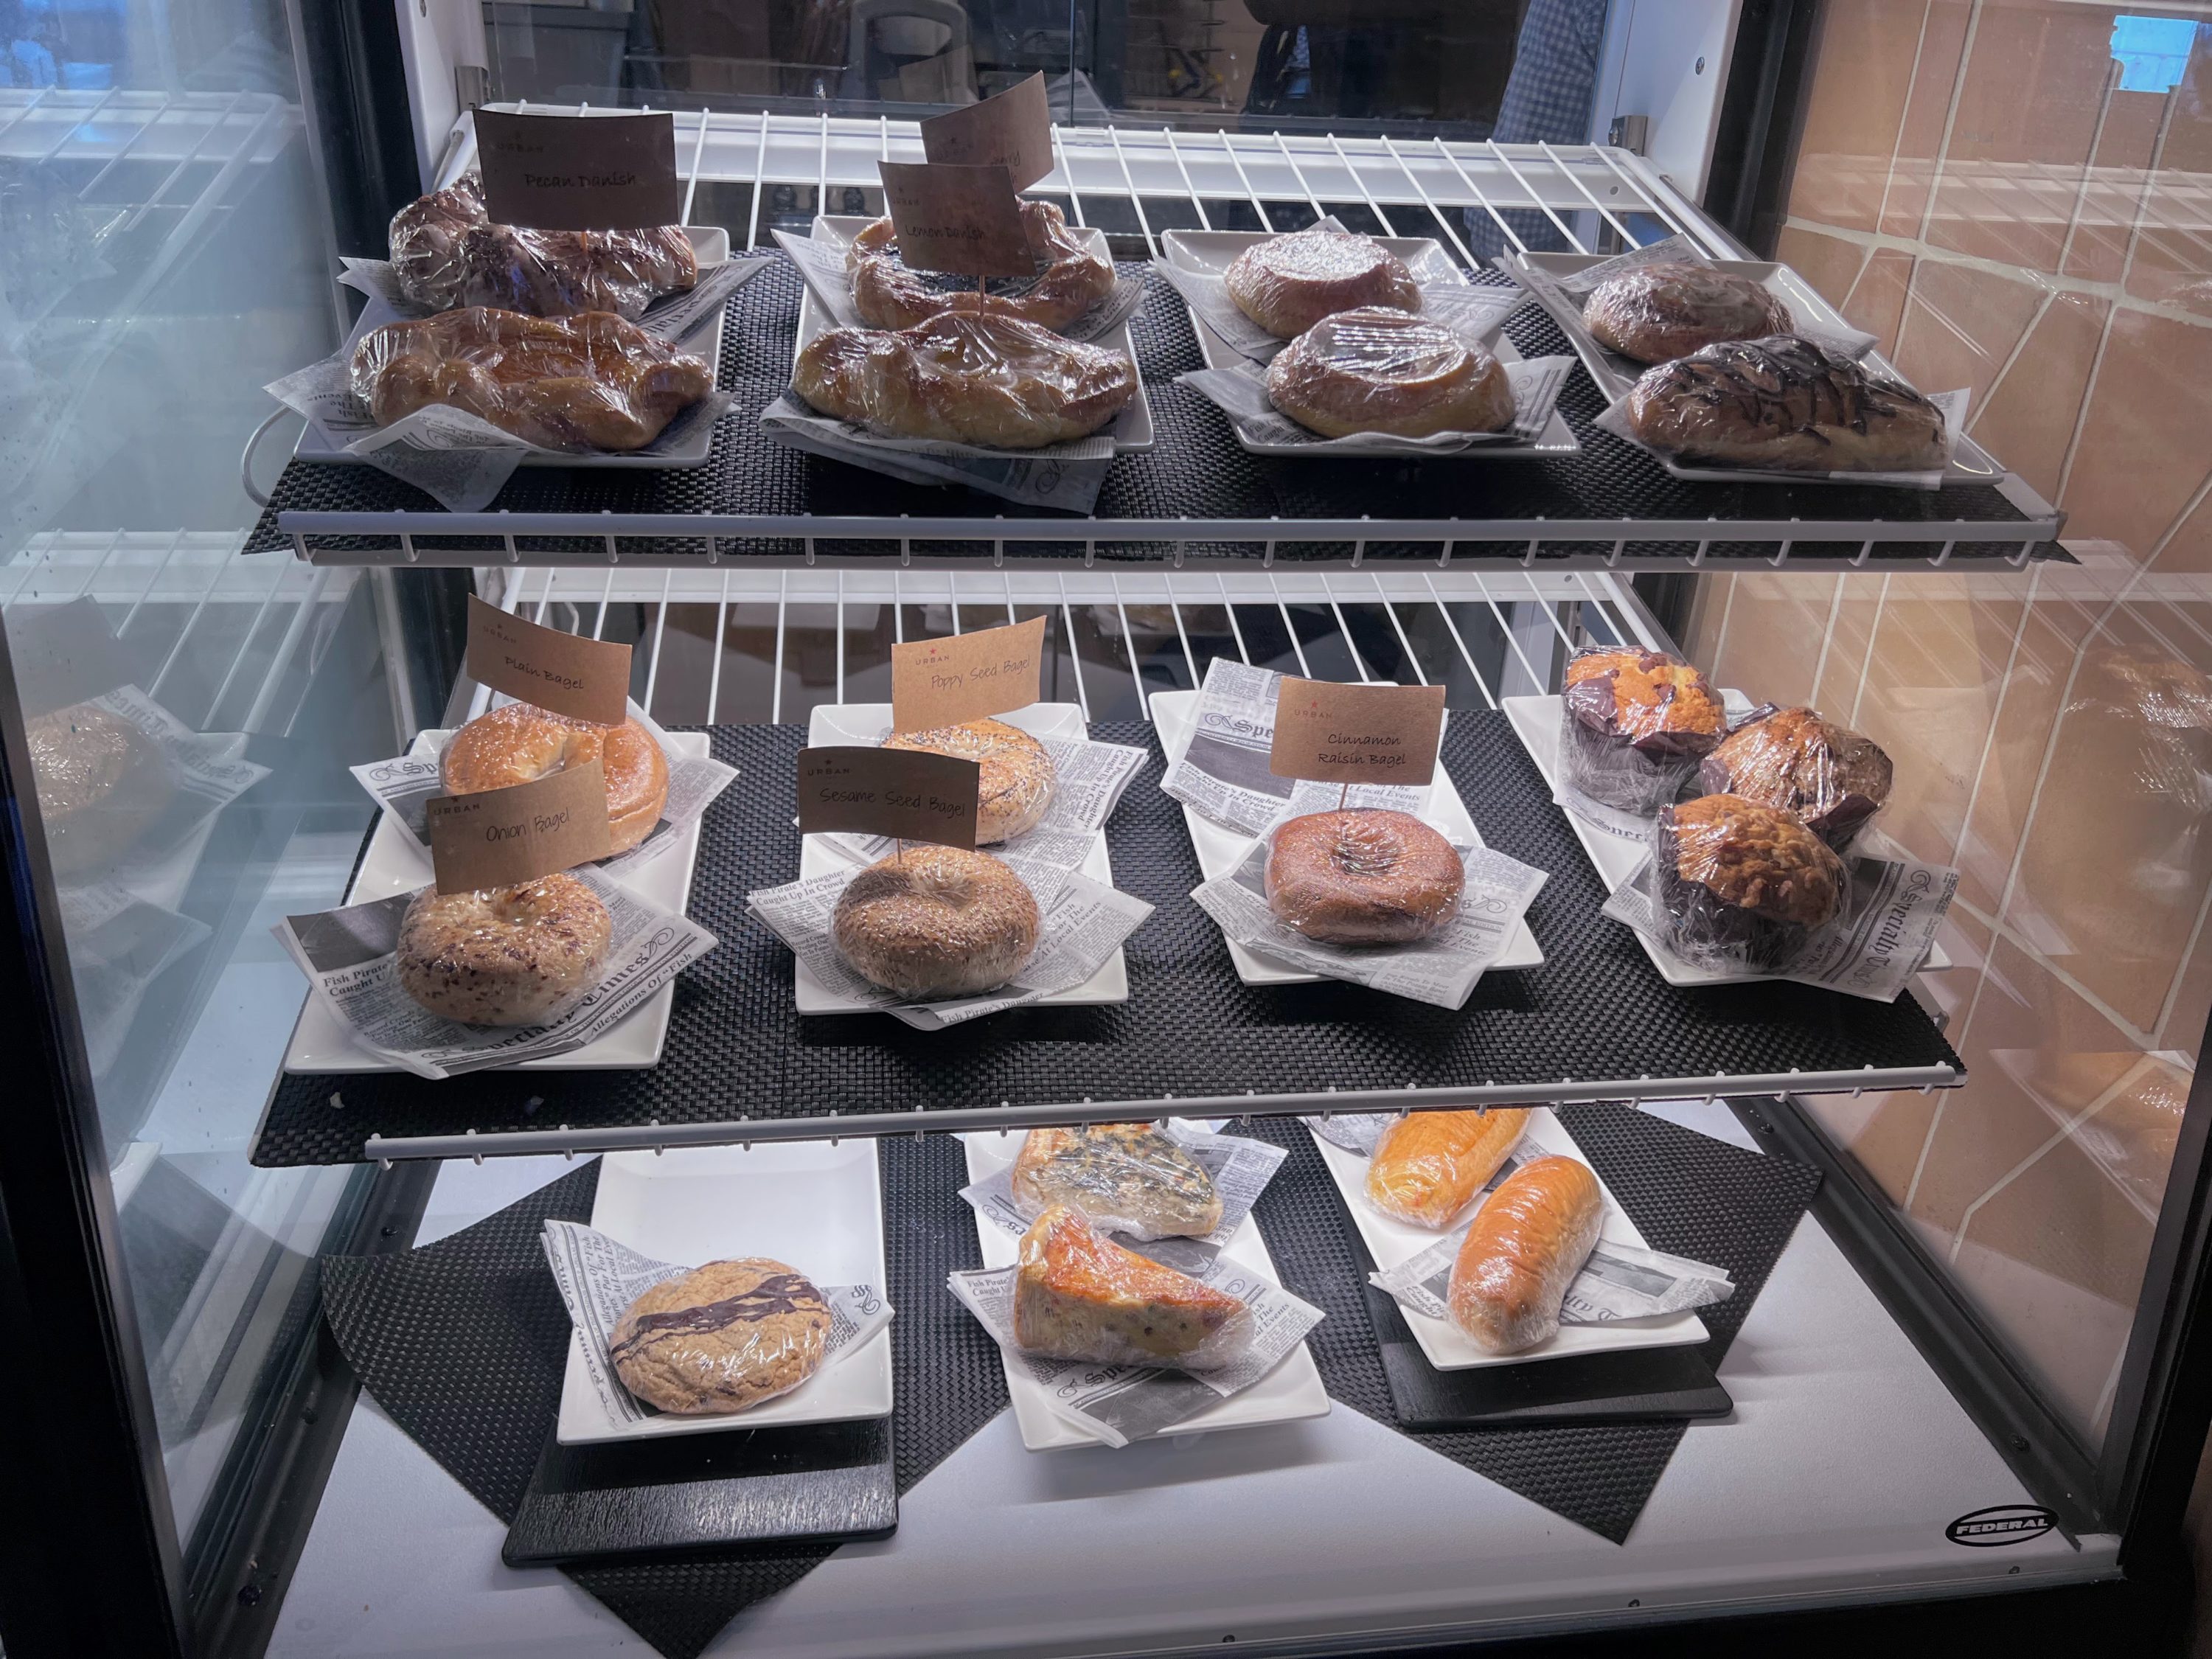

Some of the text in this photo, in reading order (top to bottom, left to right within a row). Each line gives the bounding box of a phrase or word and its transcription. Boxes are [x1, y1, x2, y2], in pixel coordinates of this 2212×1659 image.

[524, 172, 636, 187] Pecan Danish
[905, 224, 945, 239] Lemon
[916, 655, 950, 666] URBAN
[504, 655, 584, 689] Plain Bagel
[931, 655, 1031, 690] Poppy Seed Bagel
[1294, 709, 1332, 720] URBAN
[1327, 733, 1402, 745] Cinnamon
[1318, 751, 1406, 768] Raisin Bagel
[807, 767, 851, 777] URBAN
[1077, 749, 1124, 821] Caught Up In Crowd
[1356, 785, 1421, 801] Local Events
[820, 787, 965, 818] Sesame Seed Bagel
[1238, 790, 1286, 807] Daughter
[1242, 797, 1276, 812] Crowd
[434, 803, 481, 815] URBAN
[1084, 790, 1106, 829] Daughter
[486, 807, 571, 843] Onion Bagel
[771, 880, 804, 894] Pirate's
[805, 869, 845, 886] Daughter
[756, 878, 846, 907] Caught Up In Crowd
[1068, 905, 1085, 920] The
[1049, 925, 1074, 950] Local
[1074, 900, 1102, 927] Events
[1868, 889, 1924, 956] Specialty
[323, 961, 390, 988] Fish Pirate'
[581, 949, 650, 1007] Times
[329, 978, 374, 998] Caught
[591, 952, 693, 1037] Allegations Of "Fish
[964, 1004, 1000, 1019] Pirate's
[592, 1236, 602, 1247] The
[597, 1255, 608, 1274] For
[608, 1256, 619, 1281] Local
[584, 1237, 613, 1326] Allegations Of "Fish
[602, 1280, 611, 1295] Par
[967, 1278, 985, 1288] Fish
[972, 1286, 1003, 1297] Caught
[1256, 1304, 1275, 1322] The
[1262, 1302, 1290, 1328] Events
[1956, 1517, 2048, 1534] FEDERAL
